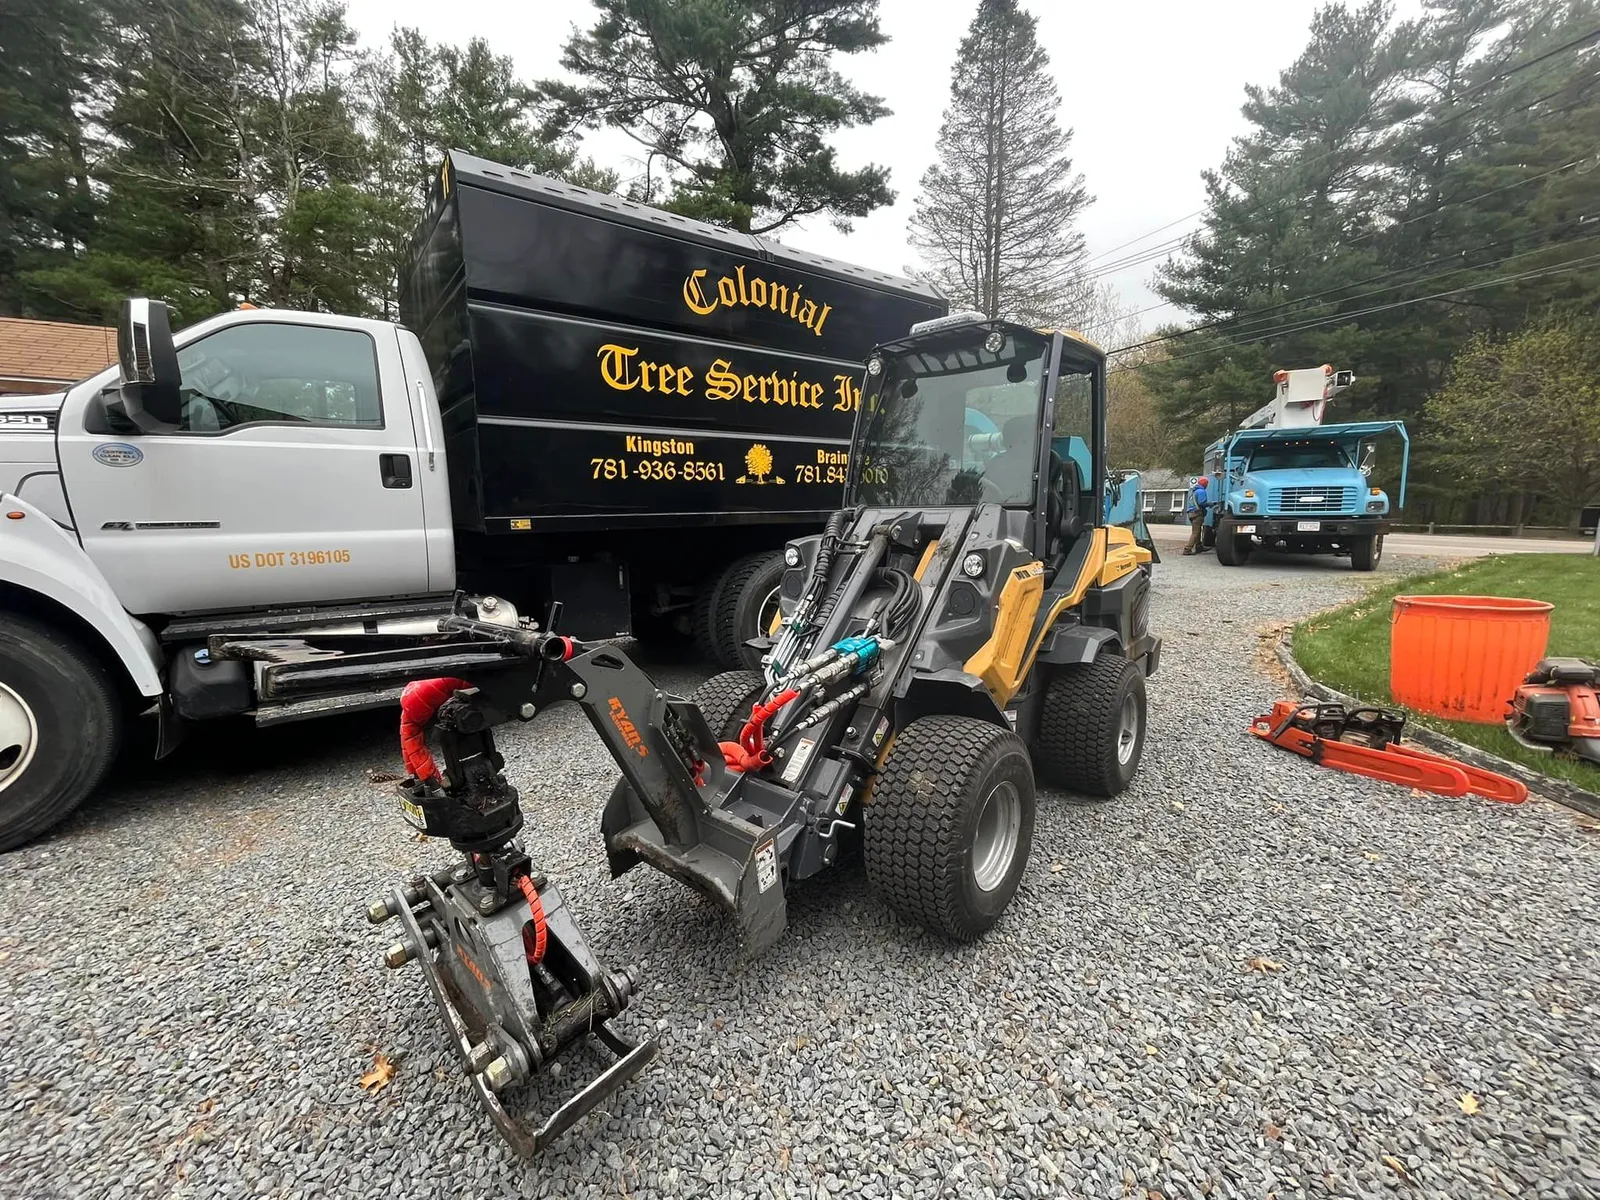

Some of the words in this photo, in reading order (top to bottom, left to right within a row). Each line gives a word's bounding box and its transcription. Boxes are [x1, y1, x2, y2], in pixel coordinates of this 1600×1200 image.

[683, 265, 833, 336] Colonial
[597, 344, 695, 396] Tree
[705, 358, 824, 409] Service
[626, 435, 695, 457] Kingston
[817, 449, 870, 466] Braine
[590, 458, 725, 481] 781-936-8561
[795, 464, 889, 485] 781.84010
[229, 553, 251, 569] US
[255, 552, 285, 568] DOT
[290, 550, 351, 566] 3196105
